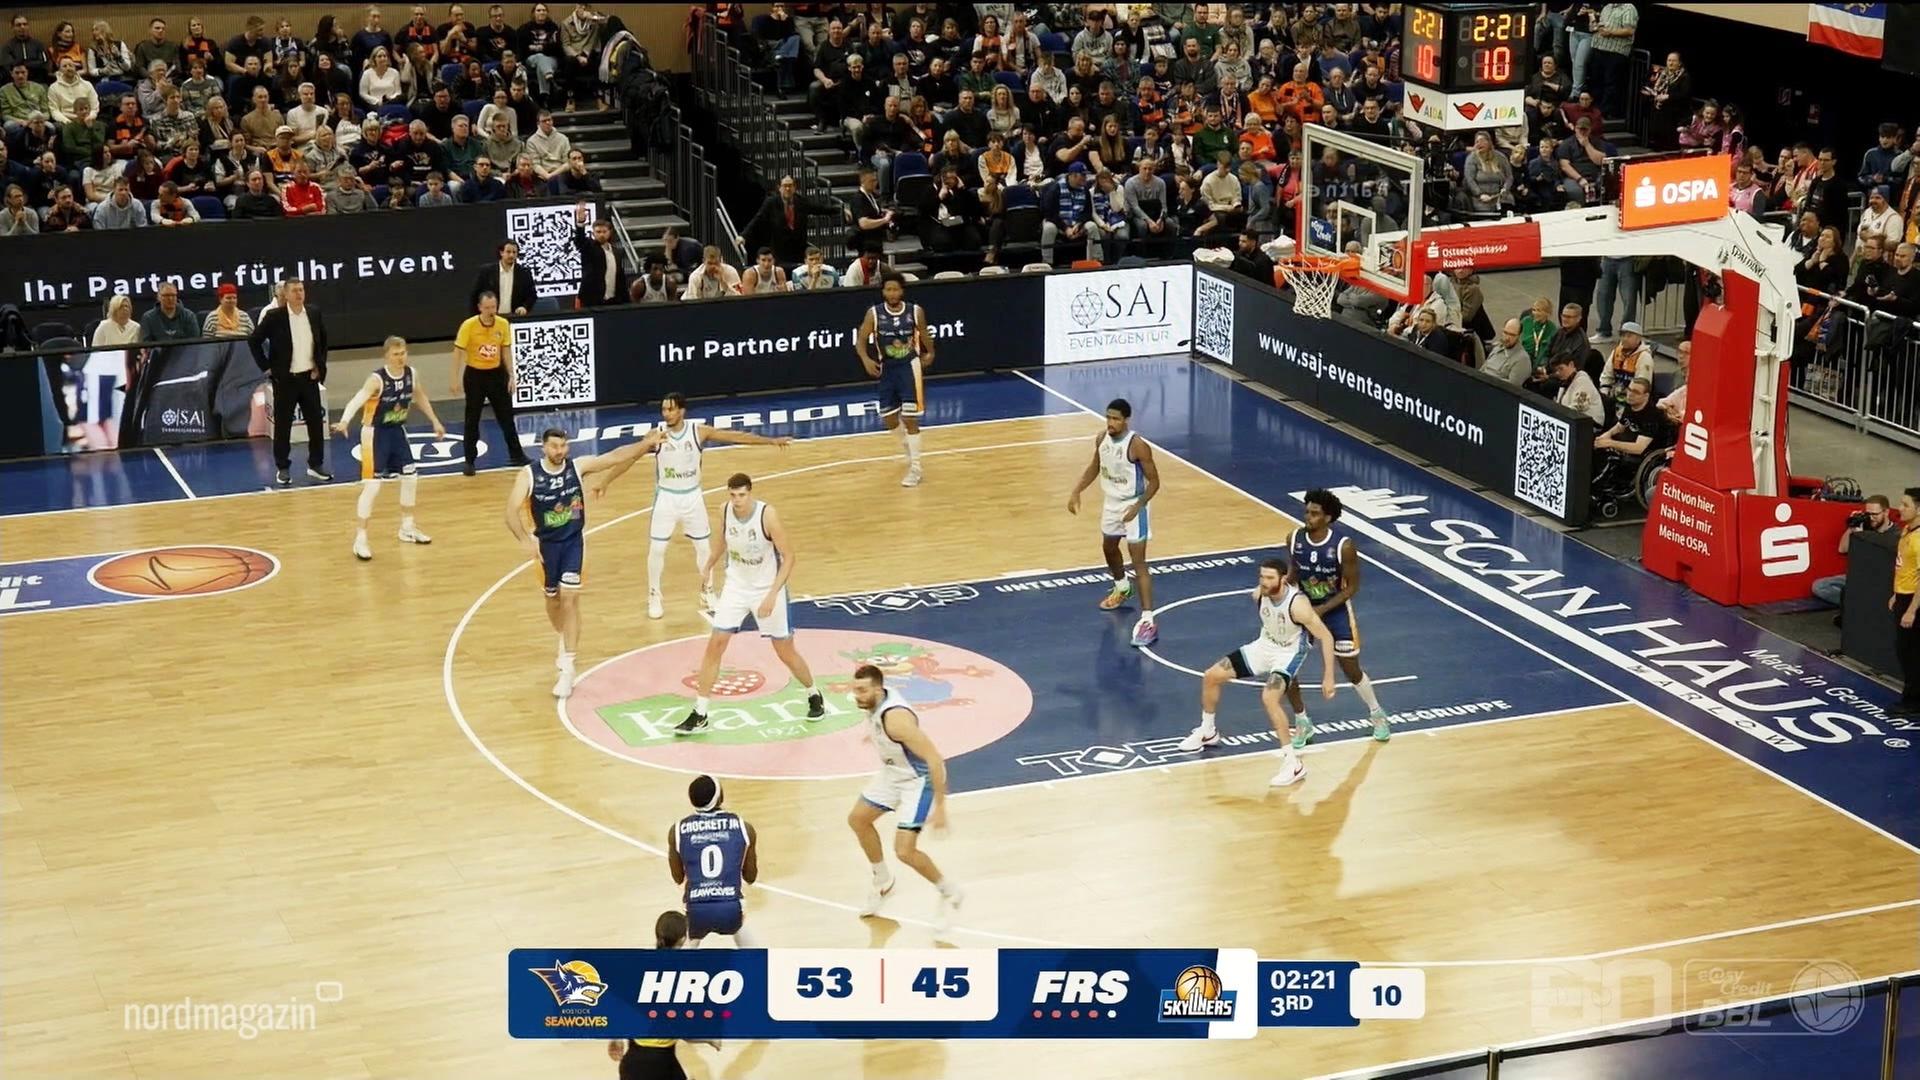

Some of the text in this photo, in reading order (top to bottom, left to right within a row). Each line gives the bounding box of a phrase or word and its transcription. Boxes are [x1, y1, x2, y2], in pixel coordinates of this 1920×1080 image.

[1413, 8, 1444, 40] 2:21
[1474, 14, 1526, 41] 2:21
[1416, 45, 1434, 79] 10
[1484, 46, 1511, 80] 10
[1423, 104, 1443, 120] AIDA
[1483, 105, 1518, 120] AIDA
[1662, 178, 1719, 205] OSPA
[24, 250, 454, 302] Ihr Partner für Ihr Event
[1443, 257, 1474, 268] Rostock
[1105, 280, 1169, 322] SAJ
[660, 343, 695, 363] Ihr
[704, 335, 801, 359] Partner
[807, 329, 844, 349] für
[1070, 329, 1170, 350] EVENTAGENTUR
[394, 380, 405, 391] 10
[1258, 331, 1484, 446] www.saj-eventagentur.com
[549, 476, 564, 489] 29
[1662, 482, 1716, 515] Echt von hier.
[1660, 503, 1713, 536] Nah bei mir.
[1659, 523, 1711, 557] Meine OSPA.
[1310, 550, 1318, 564] 8
[813, 583, 980, 616] TOP
[1393, 519, 1886, 744] SCAN HAUS
[1742, 649, 1805, 676] Made
[1799, 675, 1828, 688] in
[1627, 662, 1796, 747] MARLOW
[1016, 735, 1205, 776] TOP
[680, 818, 727, 835] CROCKETT
[701, 844, 724, 878] 0
